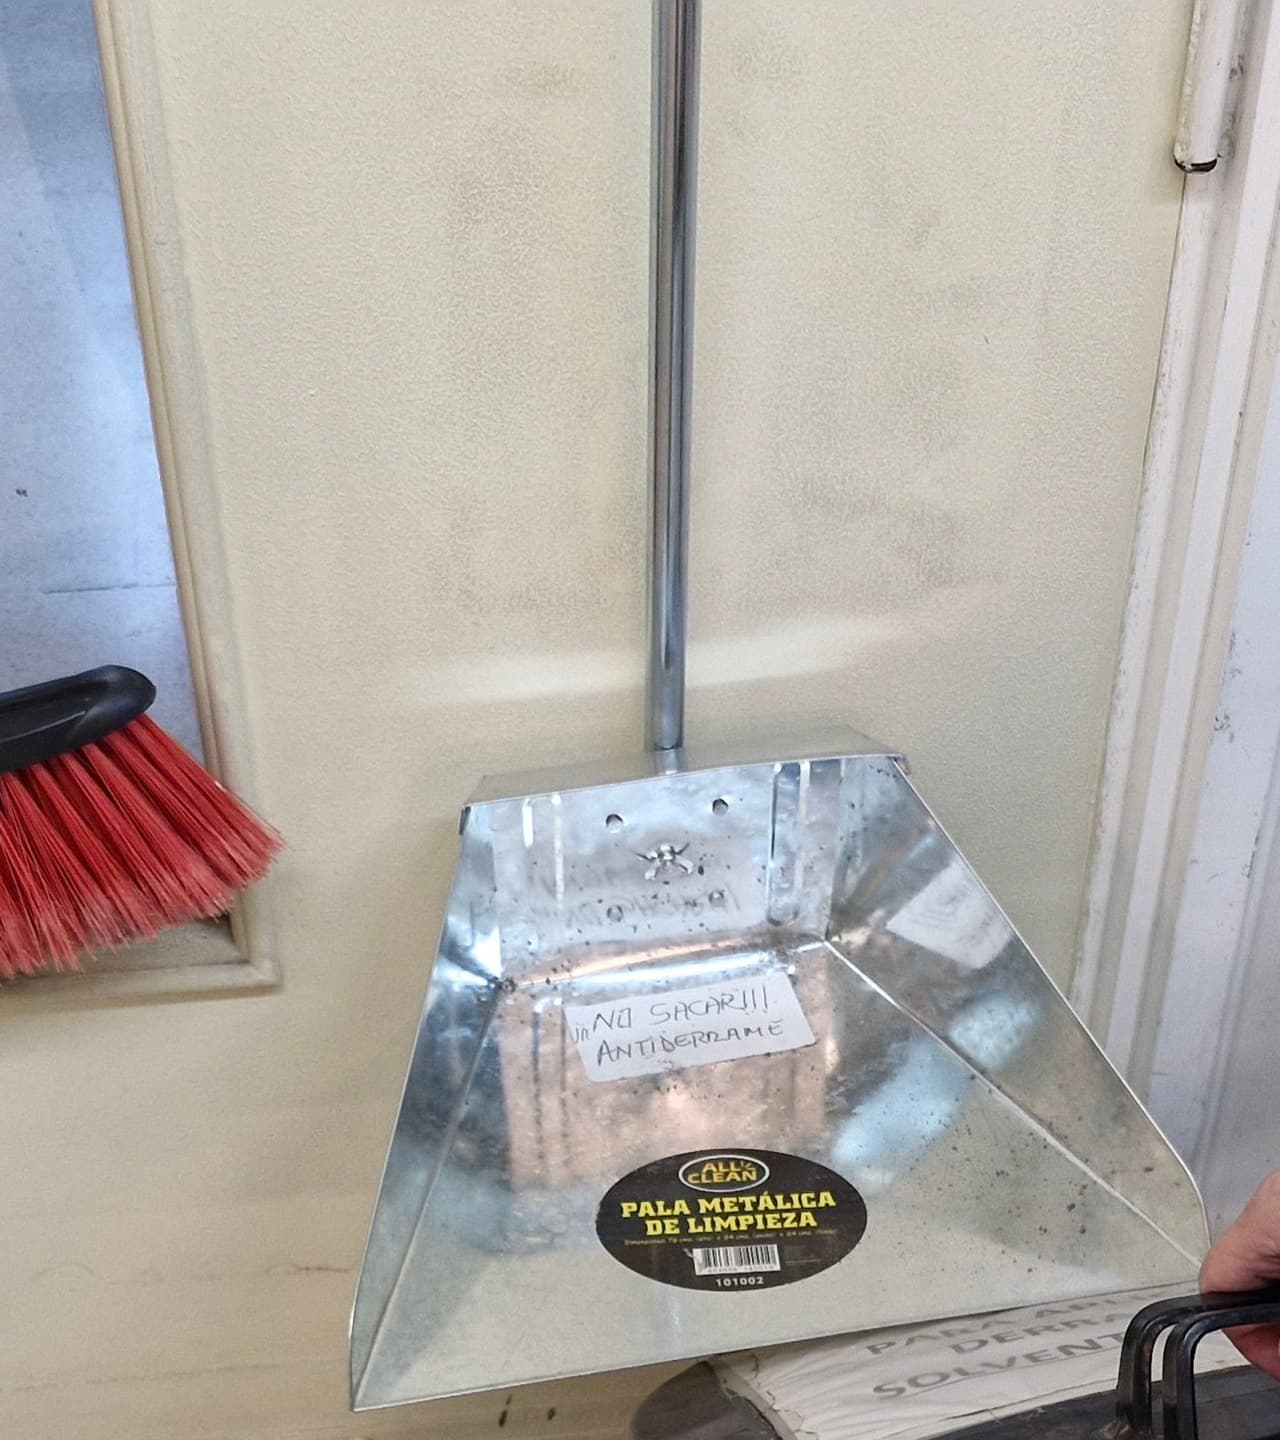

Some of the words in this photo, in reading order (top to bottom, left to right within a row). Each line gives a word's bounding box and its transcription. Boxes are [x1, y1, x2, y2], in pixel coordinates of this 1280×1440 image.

[649, 985, 769, 1026] SACAR!!!
[596, 1018, 784, 1068] ANTIDERRAME
[687, 1170, 758, 1184] CLEAN
[702, 1160, 741, 1173] ALL
[620, 1199, 691, 1219] PALA
[699, 1190, 837, 1215] METÁLICA
[646, 1219, 681, 1236] DE
[687, 1211, 818, 1234] LIMPIEZA
[715, 1275, 765, 1288] 101002
[865, 1319, 1017, 1356] PARA
[950, 1312, 1133, 1355] DERRA
[871, 1331, 1124, 1400] SOLVENT
